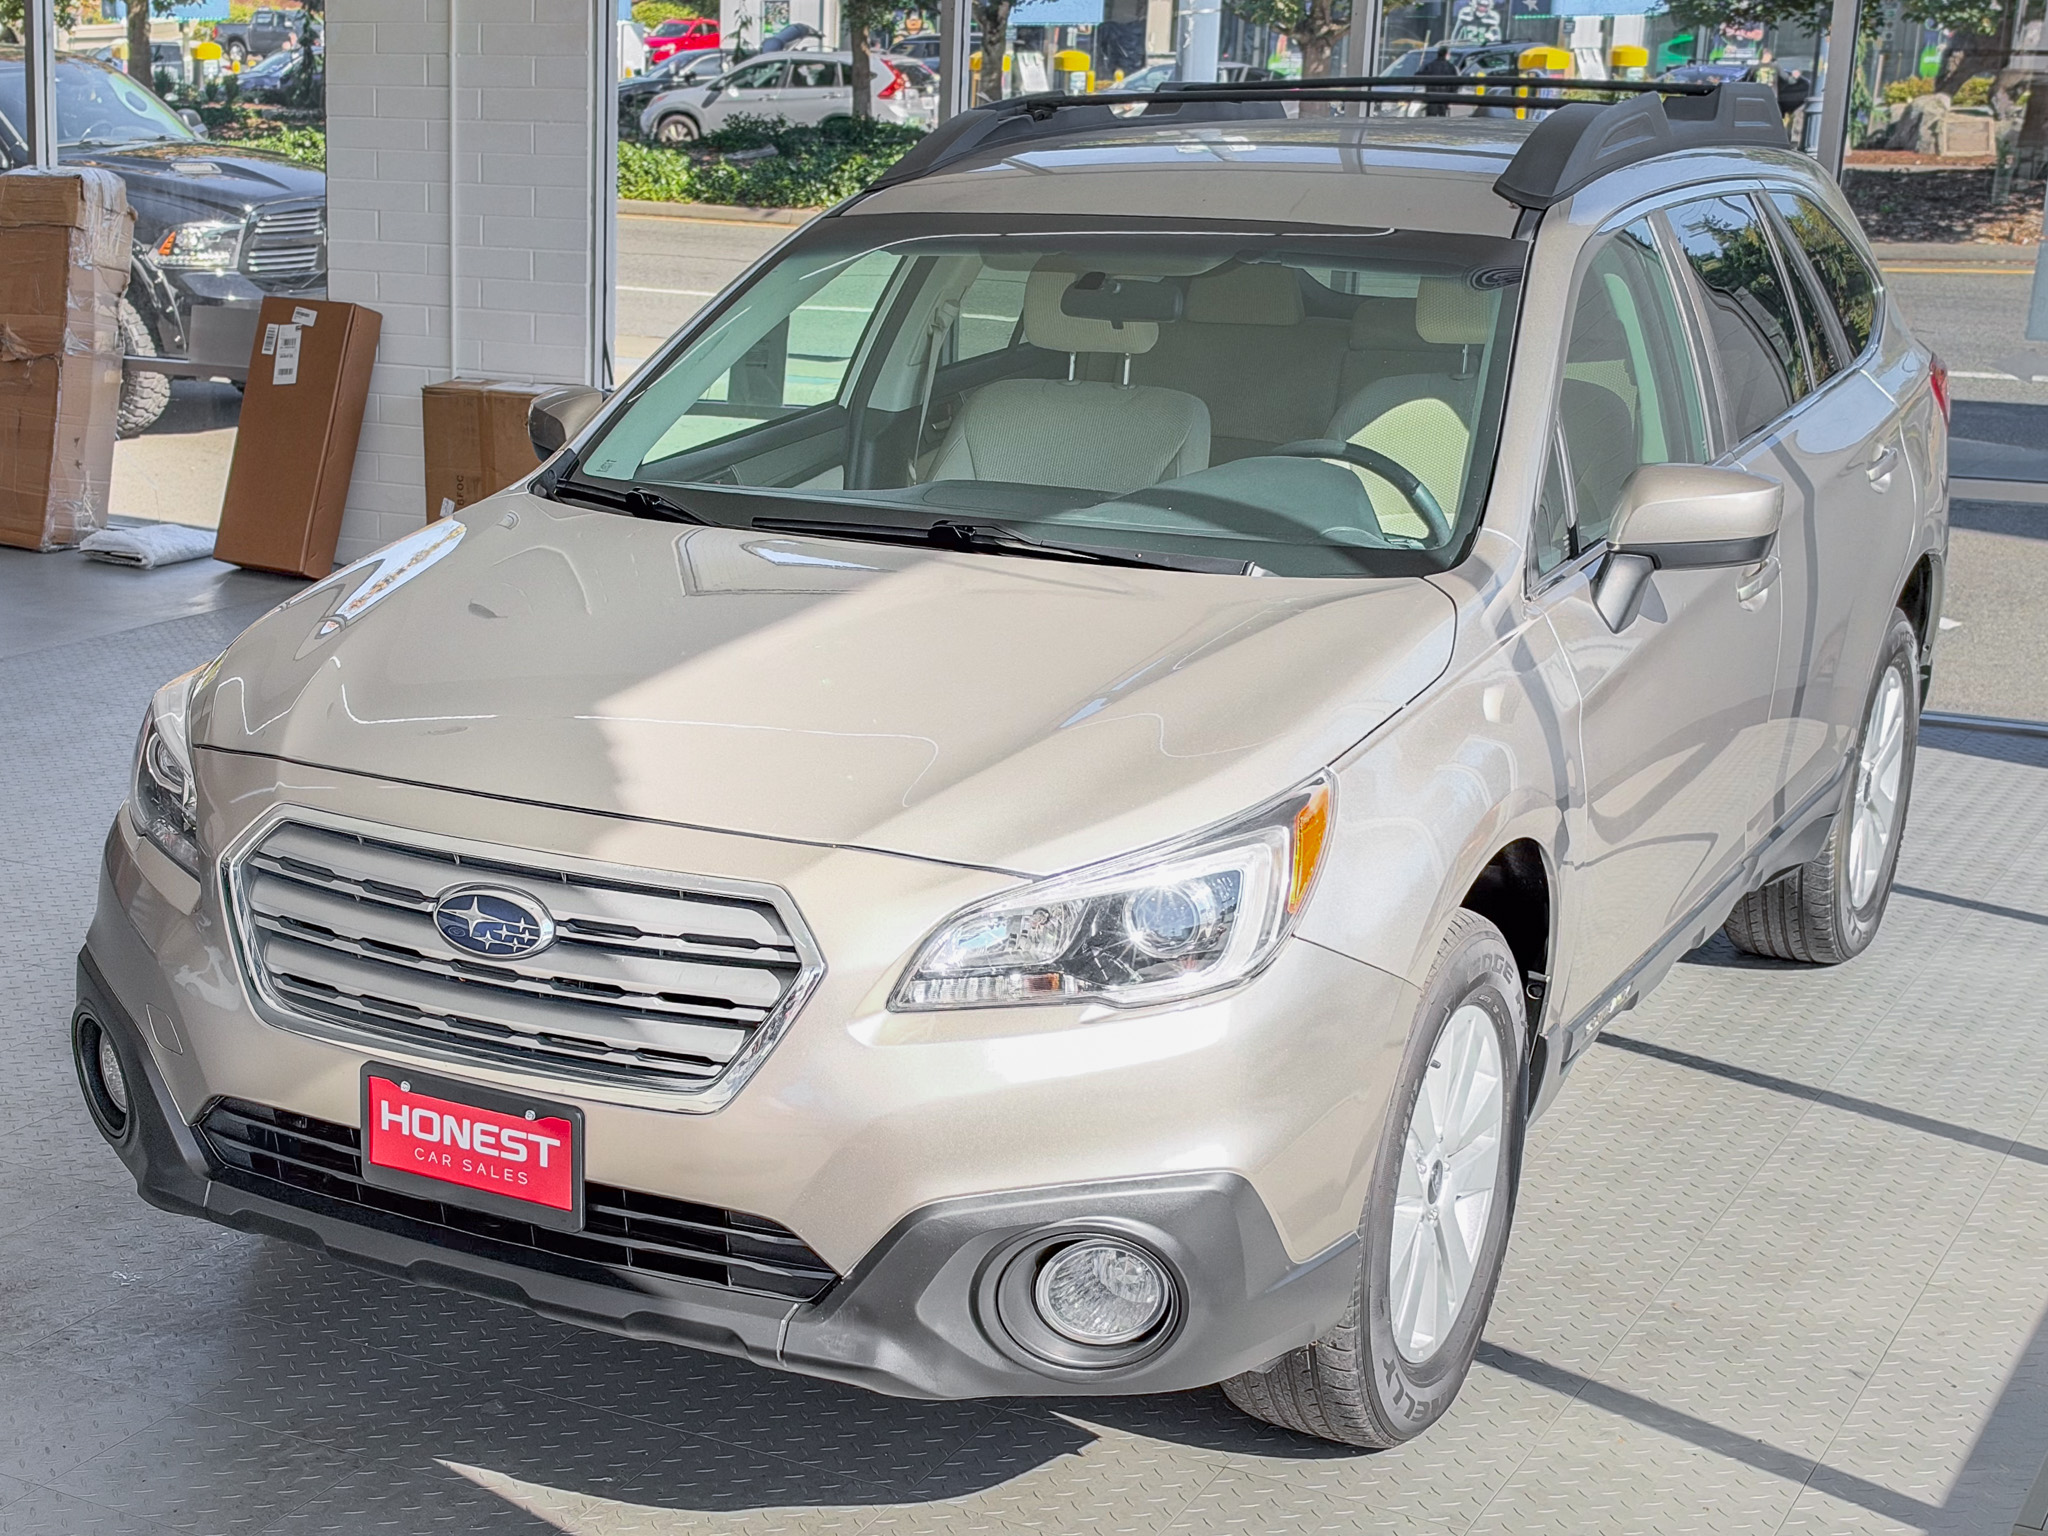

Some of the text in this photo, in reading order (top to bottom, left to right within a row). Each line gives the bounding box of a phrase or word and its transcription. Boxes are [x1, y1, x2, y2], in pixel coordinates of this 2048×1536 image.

[381, 1099, 561, 1168] HONEST
[414, 1147, 528, 1185] CAR SALES
